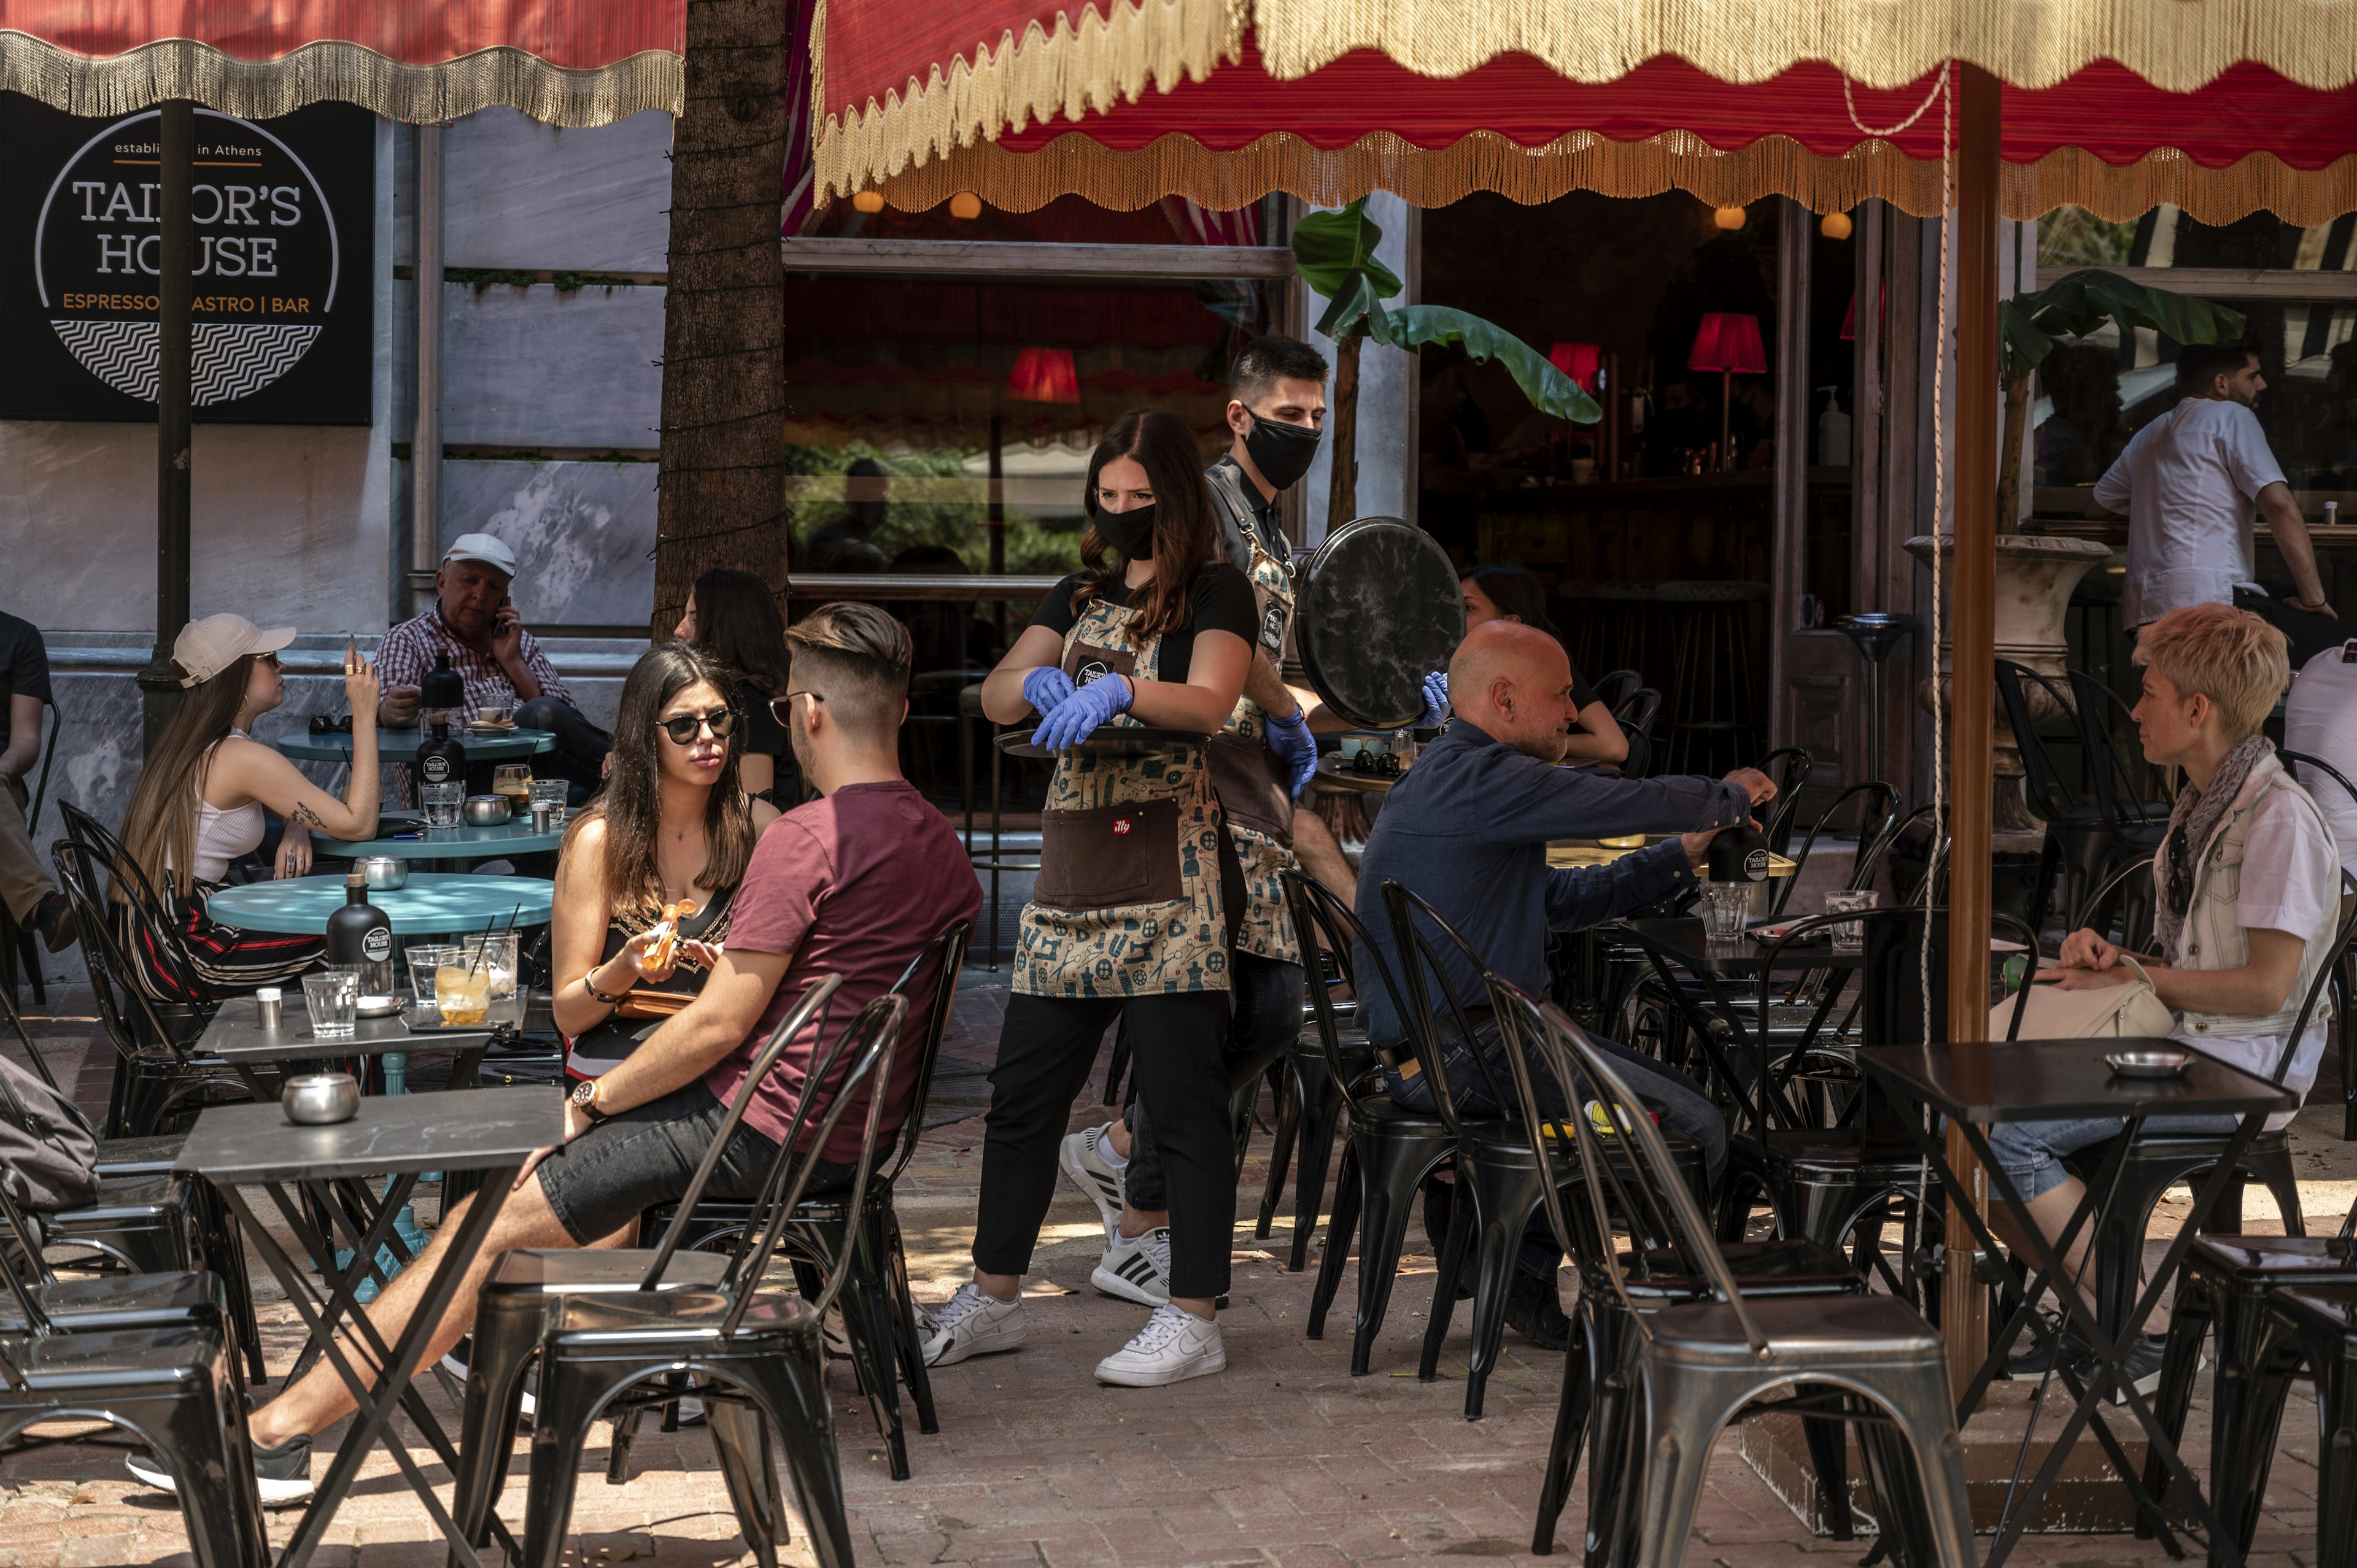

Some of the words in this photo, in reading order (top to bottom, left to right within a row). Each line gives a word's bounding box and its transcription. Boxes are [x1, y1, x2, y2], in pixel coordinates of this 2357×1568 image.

[115, 142, 161, 153] establi
[197, 144, 209, 155] in
[215, 145, 261, 156] Athens
[72, 182, 301, 226] TAIOR'S
[97, 234, 277, 277] HOUSE
[63, 293, 160, 311] ESPRESSO
[191, 296, 255, 312] ASTRO
[272, 298, 310, 313] BAR
[1114, 820, 1130, 834] illy
